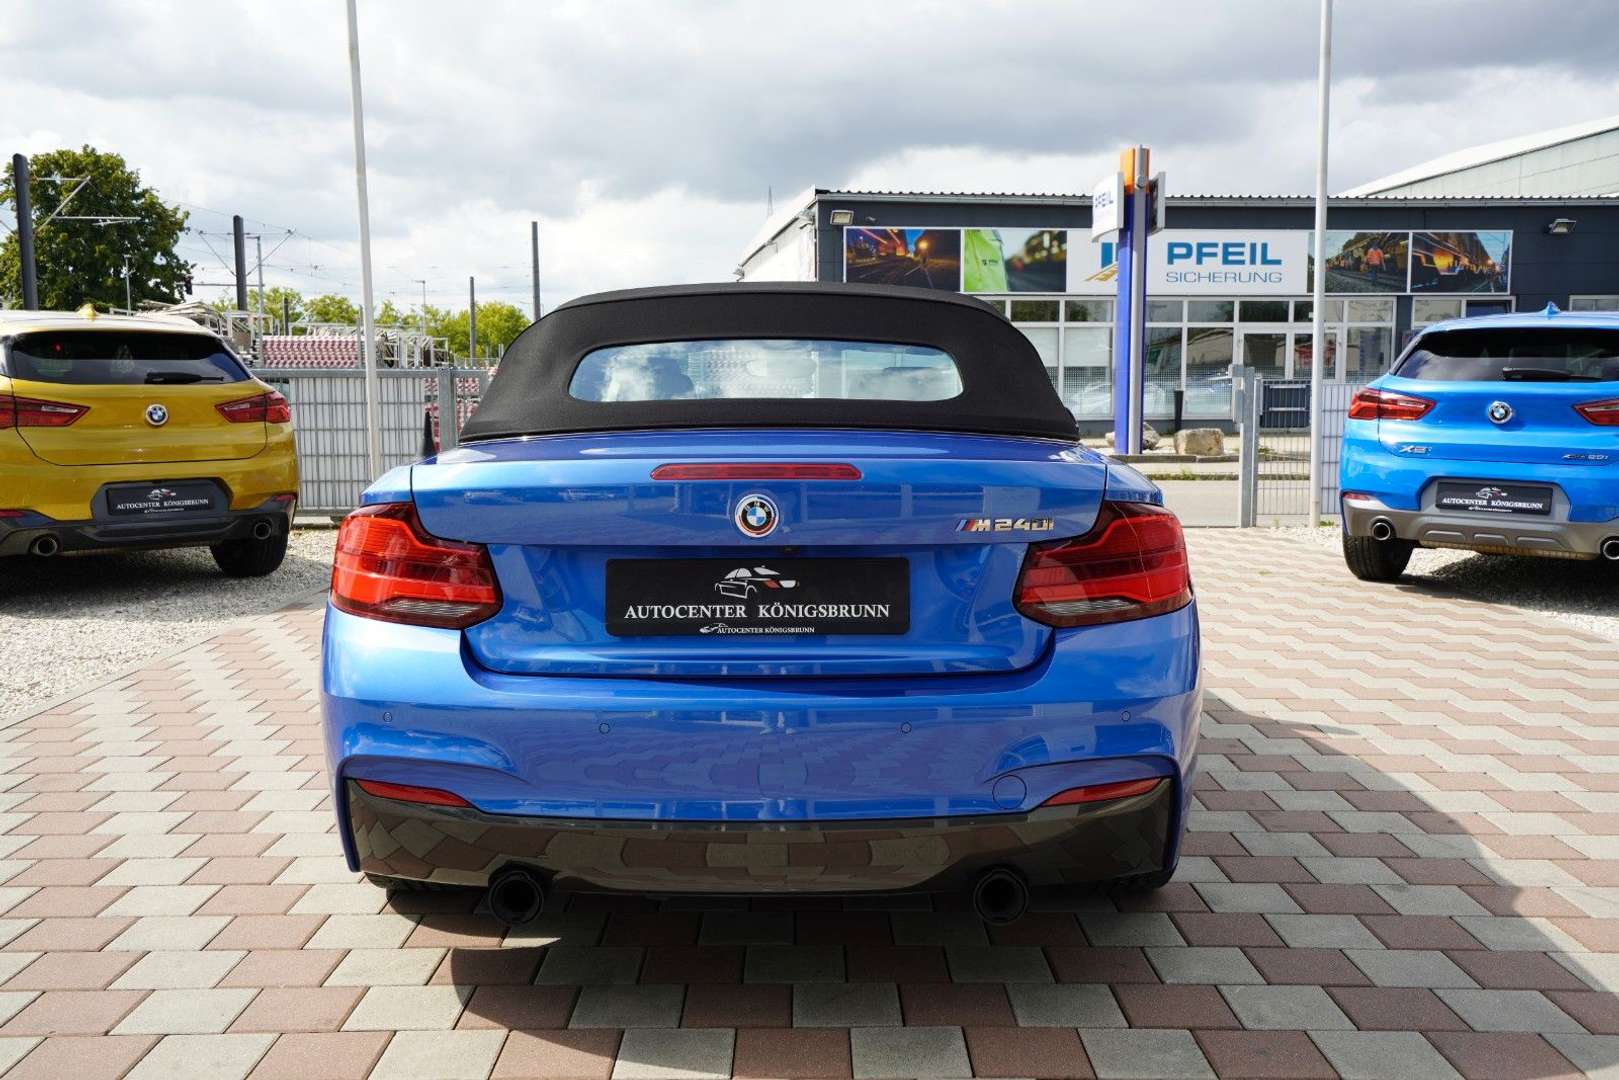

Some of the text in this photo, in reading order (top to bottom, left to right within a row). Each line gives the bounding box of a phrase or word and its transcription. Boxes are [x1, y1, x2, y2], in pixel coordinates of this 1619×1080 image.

[1167, 242, 1282, 265] PFEIL
[1166, 271, 1282, 283] SICHERUNG
[117, 502, 160, 510] AUTOCENTER
[1442, 497, 1488, 506] AUTOCENTER
[624, 605, 747, 619] AUTOCENTER
[757, 602, 890, 618] KÖNIGSBRUNN
[717, 626, 763, 634] AUTOCENTER
[764, 625, 815, 634] KÖNIGSBRUNN
